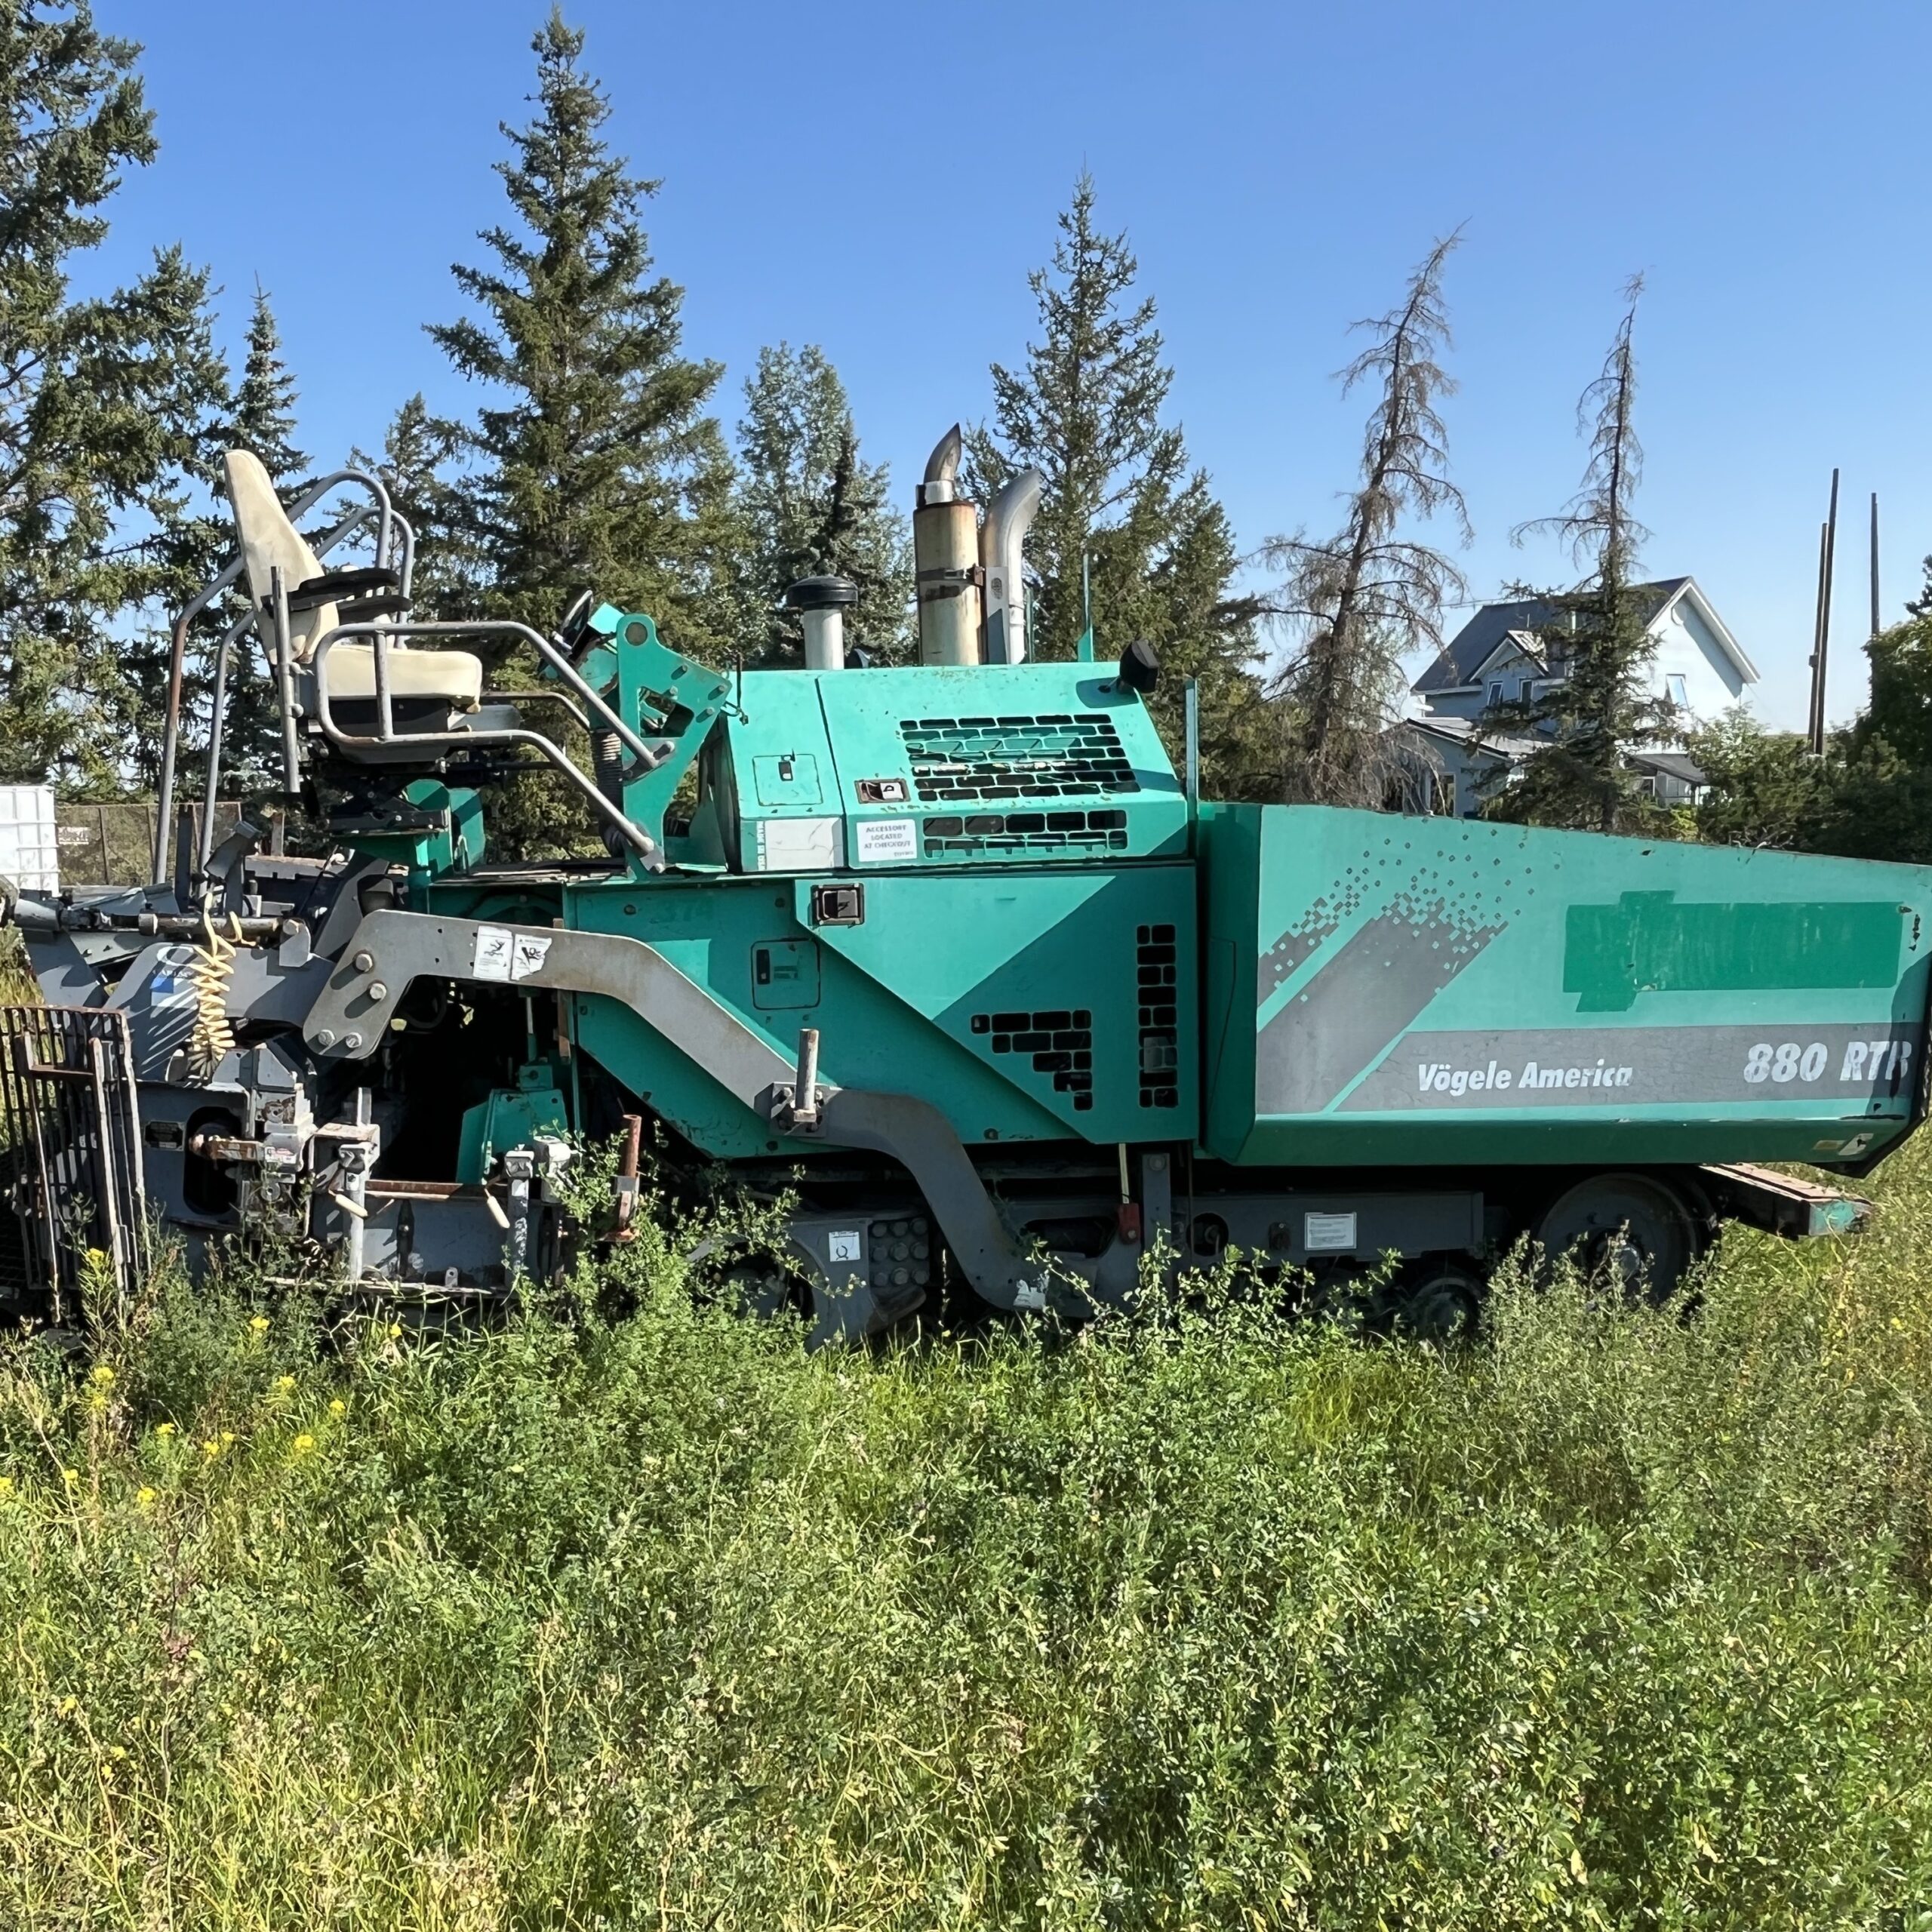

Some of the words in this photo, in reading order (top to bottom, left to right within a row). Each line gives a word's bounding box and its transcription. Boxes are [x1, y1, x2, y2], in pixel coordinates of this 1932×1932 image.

[871, 832, 903, 841] LOCATED
[1418, 1060, 1512, 1097] Vögele
[1518, 1058, 1633, 1088] America
[1743, 1042, 1828, 1083] 880
